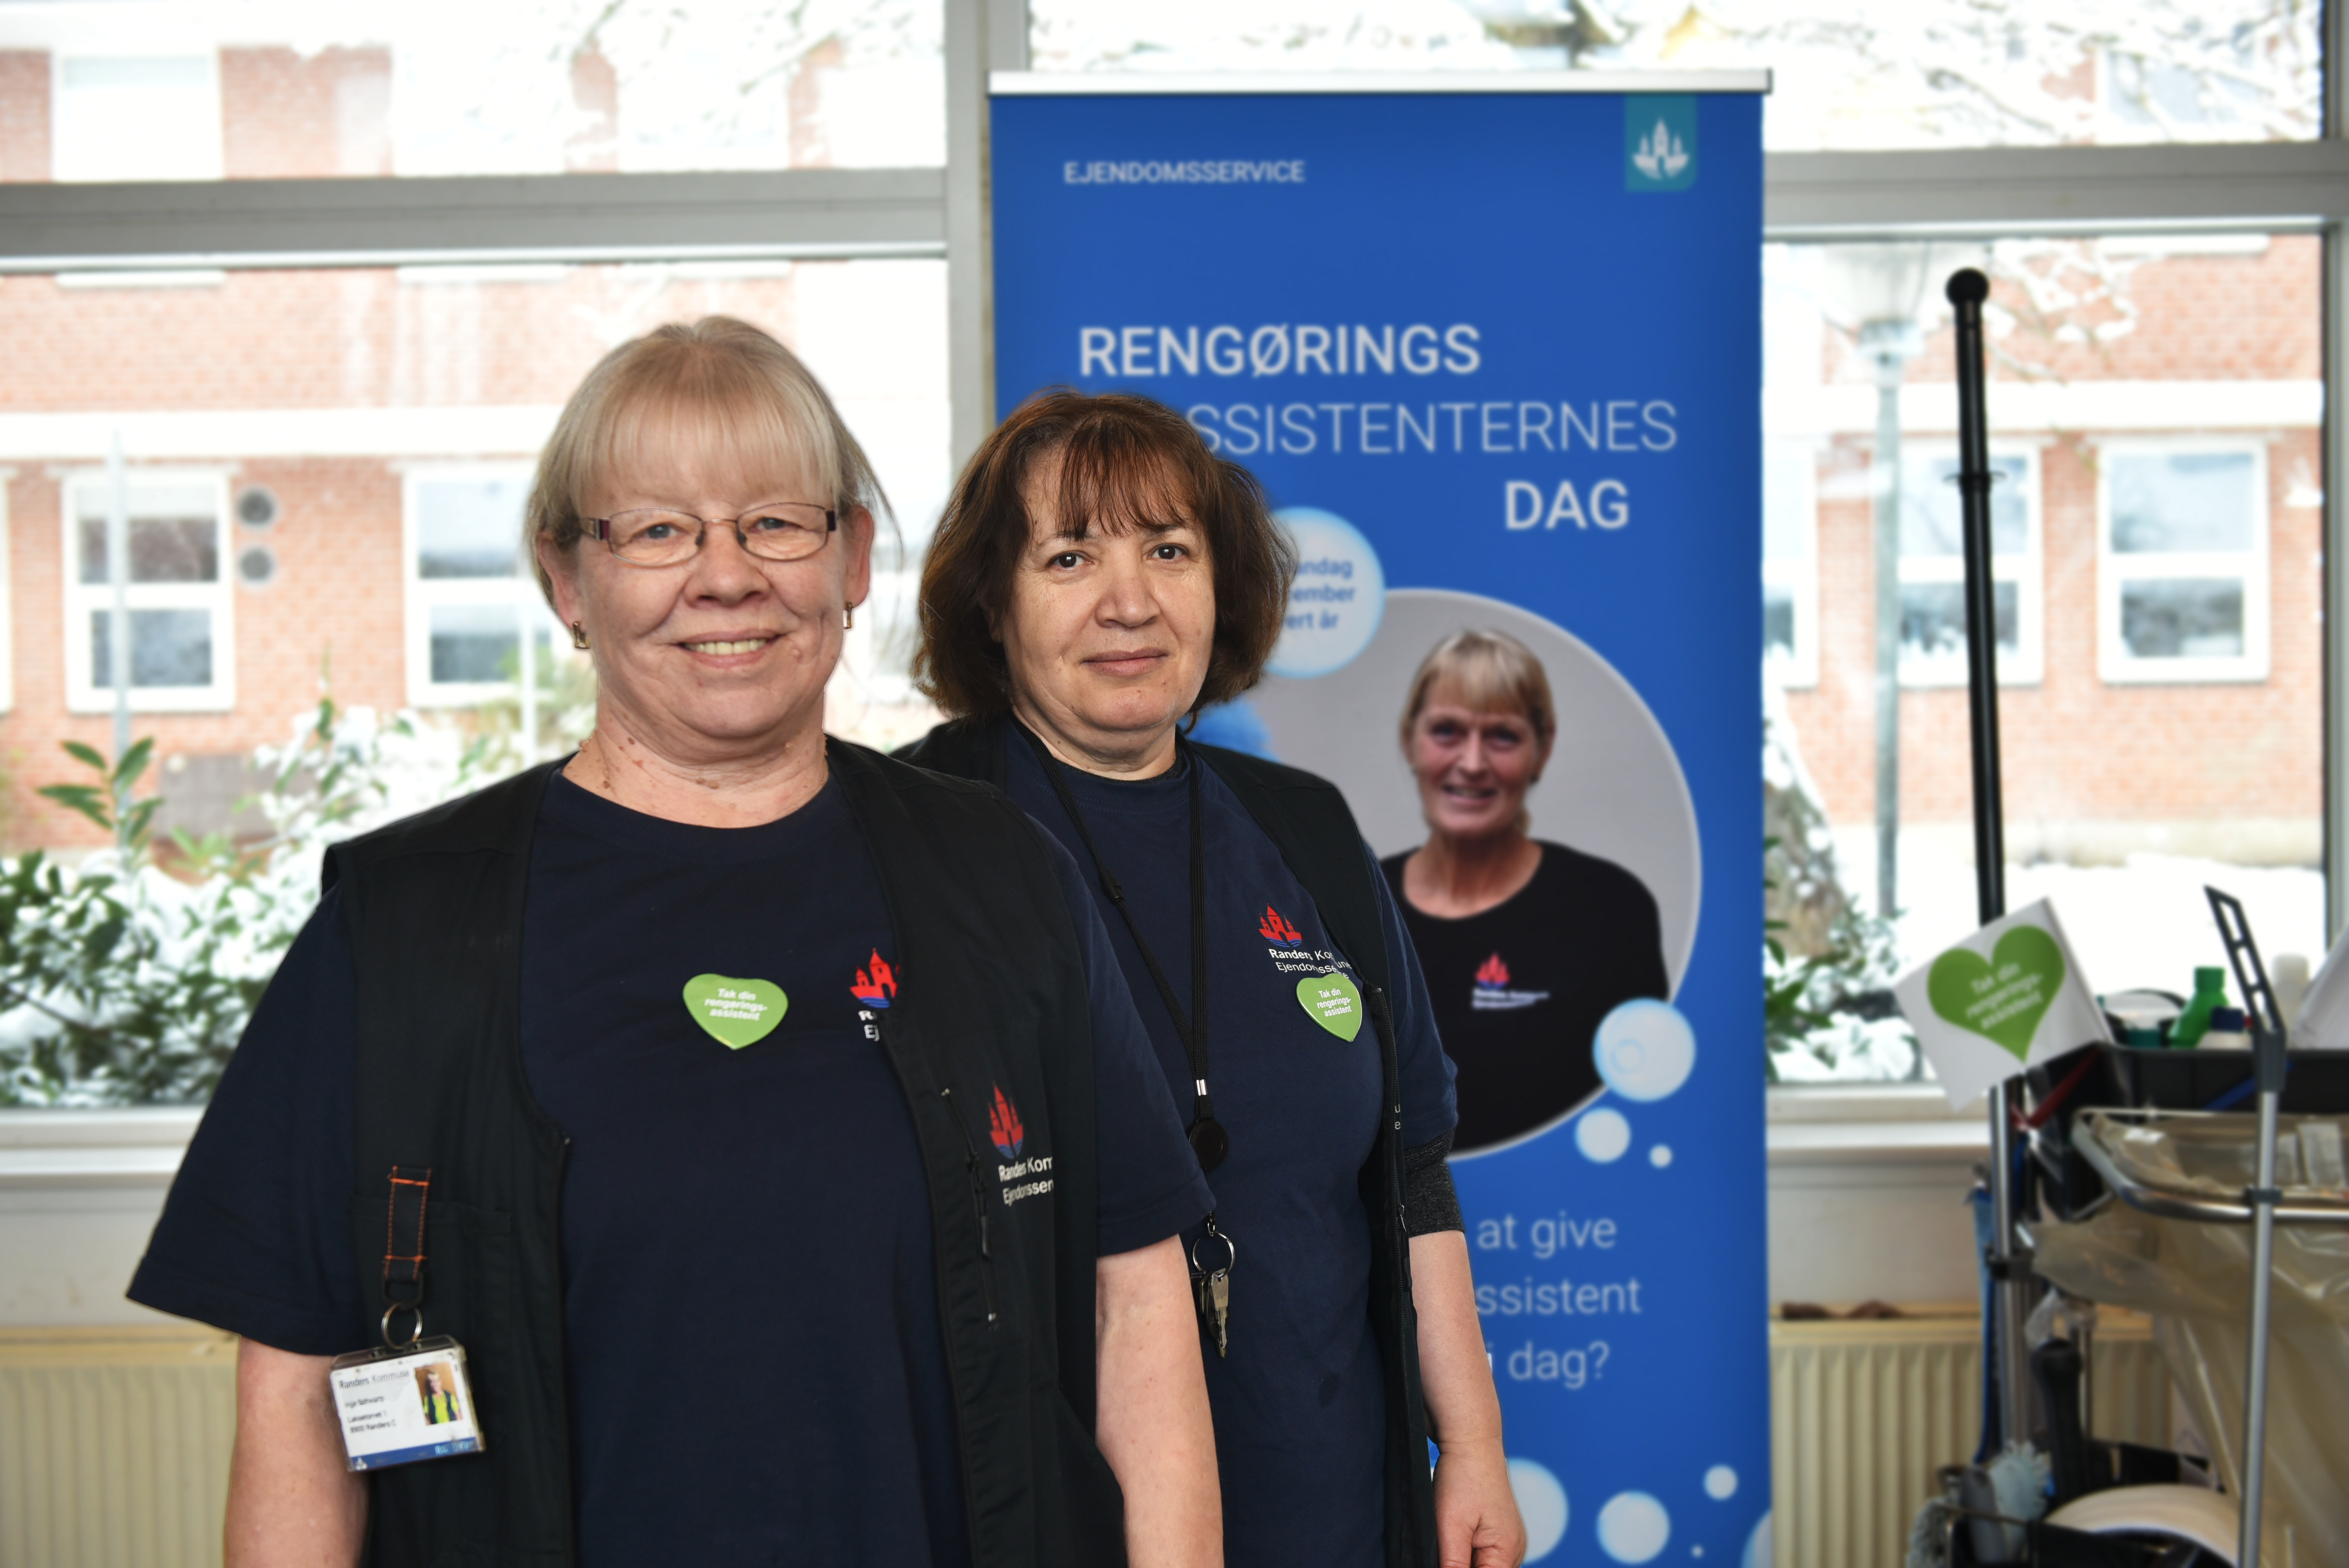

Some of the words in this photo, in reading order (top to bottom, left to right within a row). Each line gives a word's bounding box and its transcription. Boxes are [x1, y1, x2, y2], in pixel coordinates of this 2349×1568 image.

[1062, 160, 1306, 184] EJENDOMSSERVICE
[1079, 323, 1482, 377] RENGØRINGS
[1504, 479, 1630, 530] DAG
[1269, 949, 1313, 960] Randers
[718, 988, 737, 998] Tak
[738, 991, 756, 1001] din
[1318, 989, 1331, 998] Tak
[1331, 988, 1341, 996] din
[1317, 997, 1351, 1009] rengørings-
[709, 1009, 760, 1021] assistent
[1324, 1005, 1352, 1017] assistent
[1477, 1213, 1517, 1249] at
[1531, 1210, 1617, 1259] give
[1508, 1341, 1610, 1389] dag?
